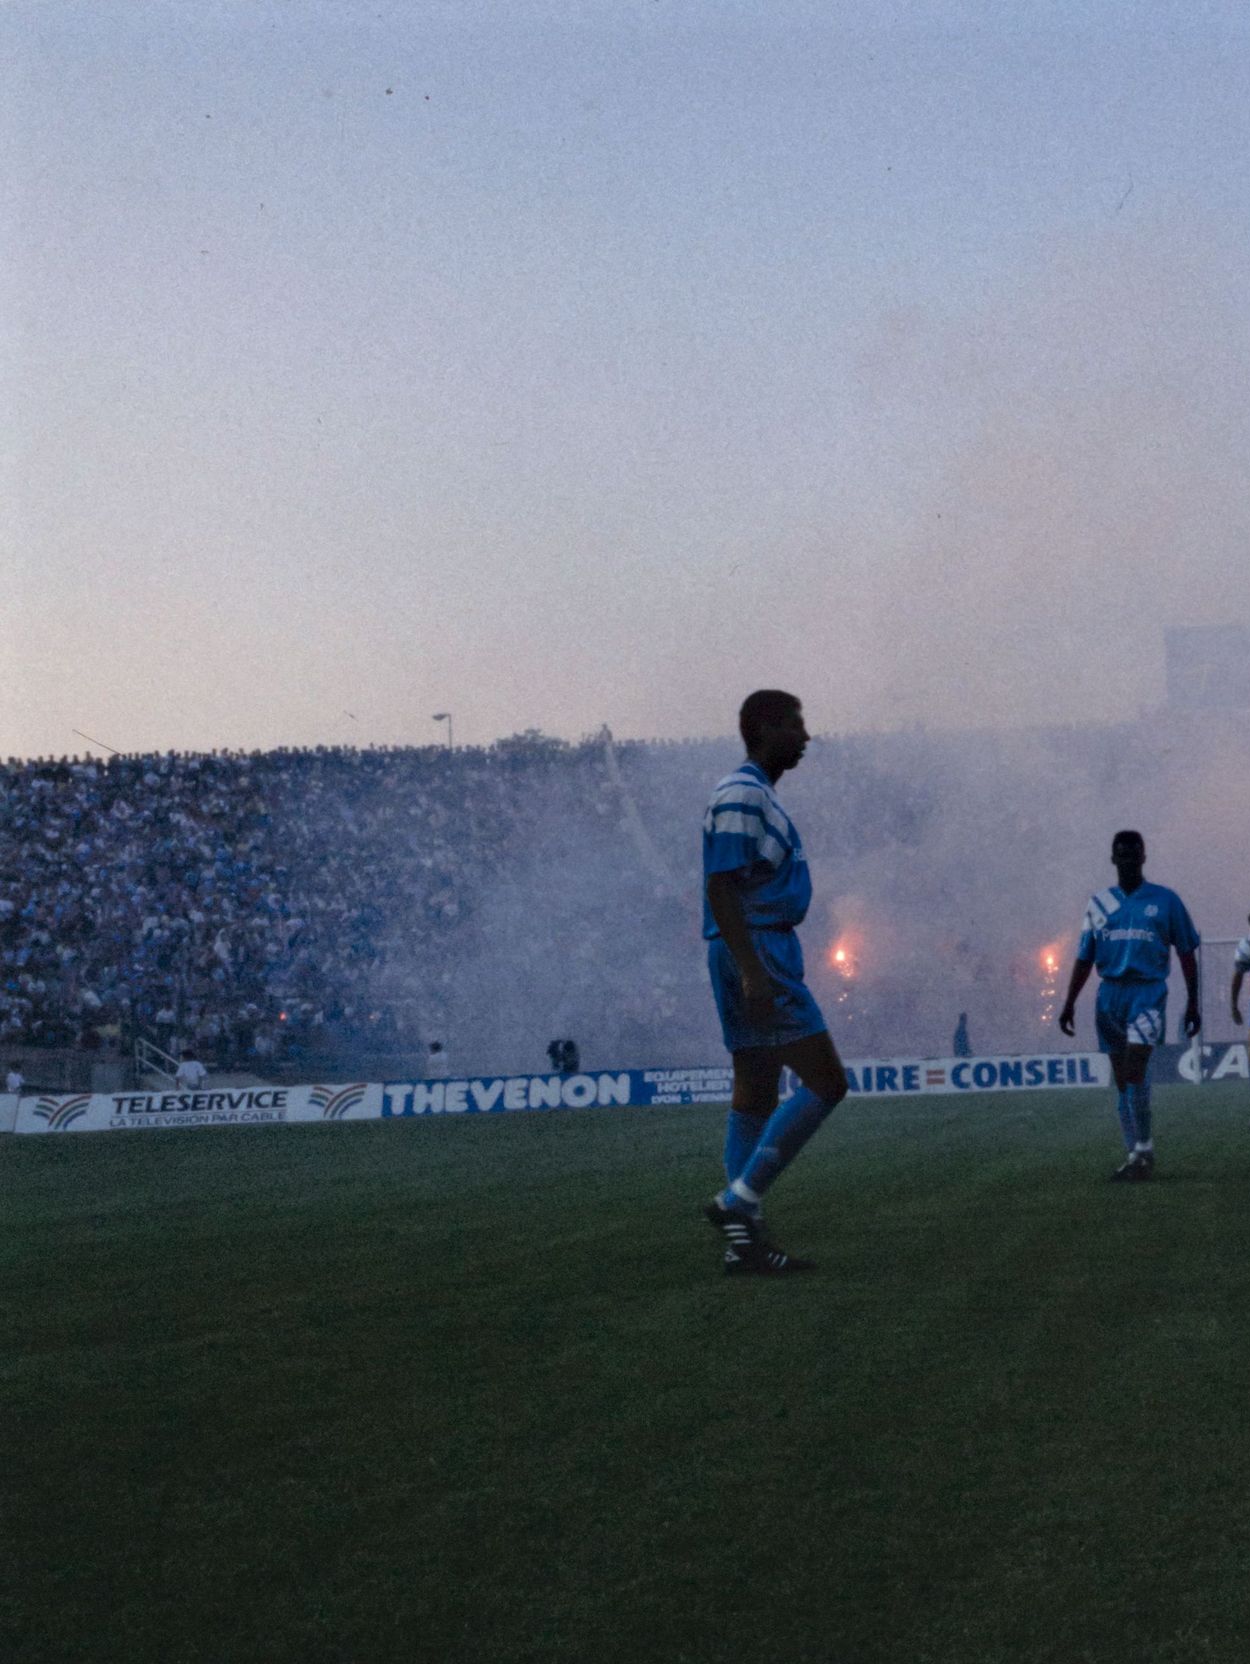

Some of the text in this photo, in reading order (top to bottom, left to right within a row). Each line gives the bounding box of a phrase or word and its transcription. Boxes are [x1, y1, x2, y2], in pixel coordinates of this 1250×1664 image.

[951, 1058, 1098, 1089] CONSEIL
[112, 1090, 288, 1114] TELESERVICE
[384, 1073, 631, 1116] THEVENON
[109, 1117, 125, 1127] LA
[211, 1113, 238, 1124] PAR
[240, 1111, 287, 1122] CABLE
